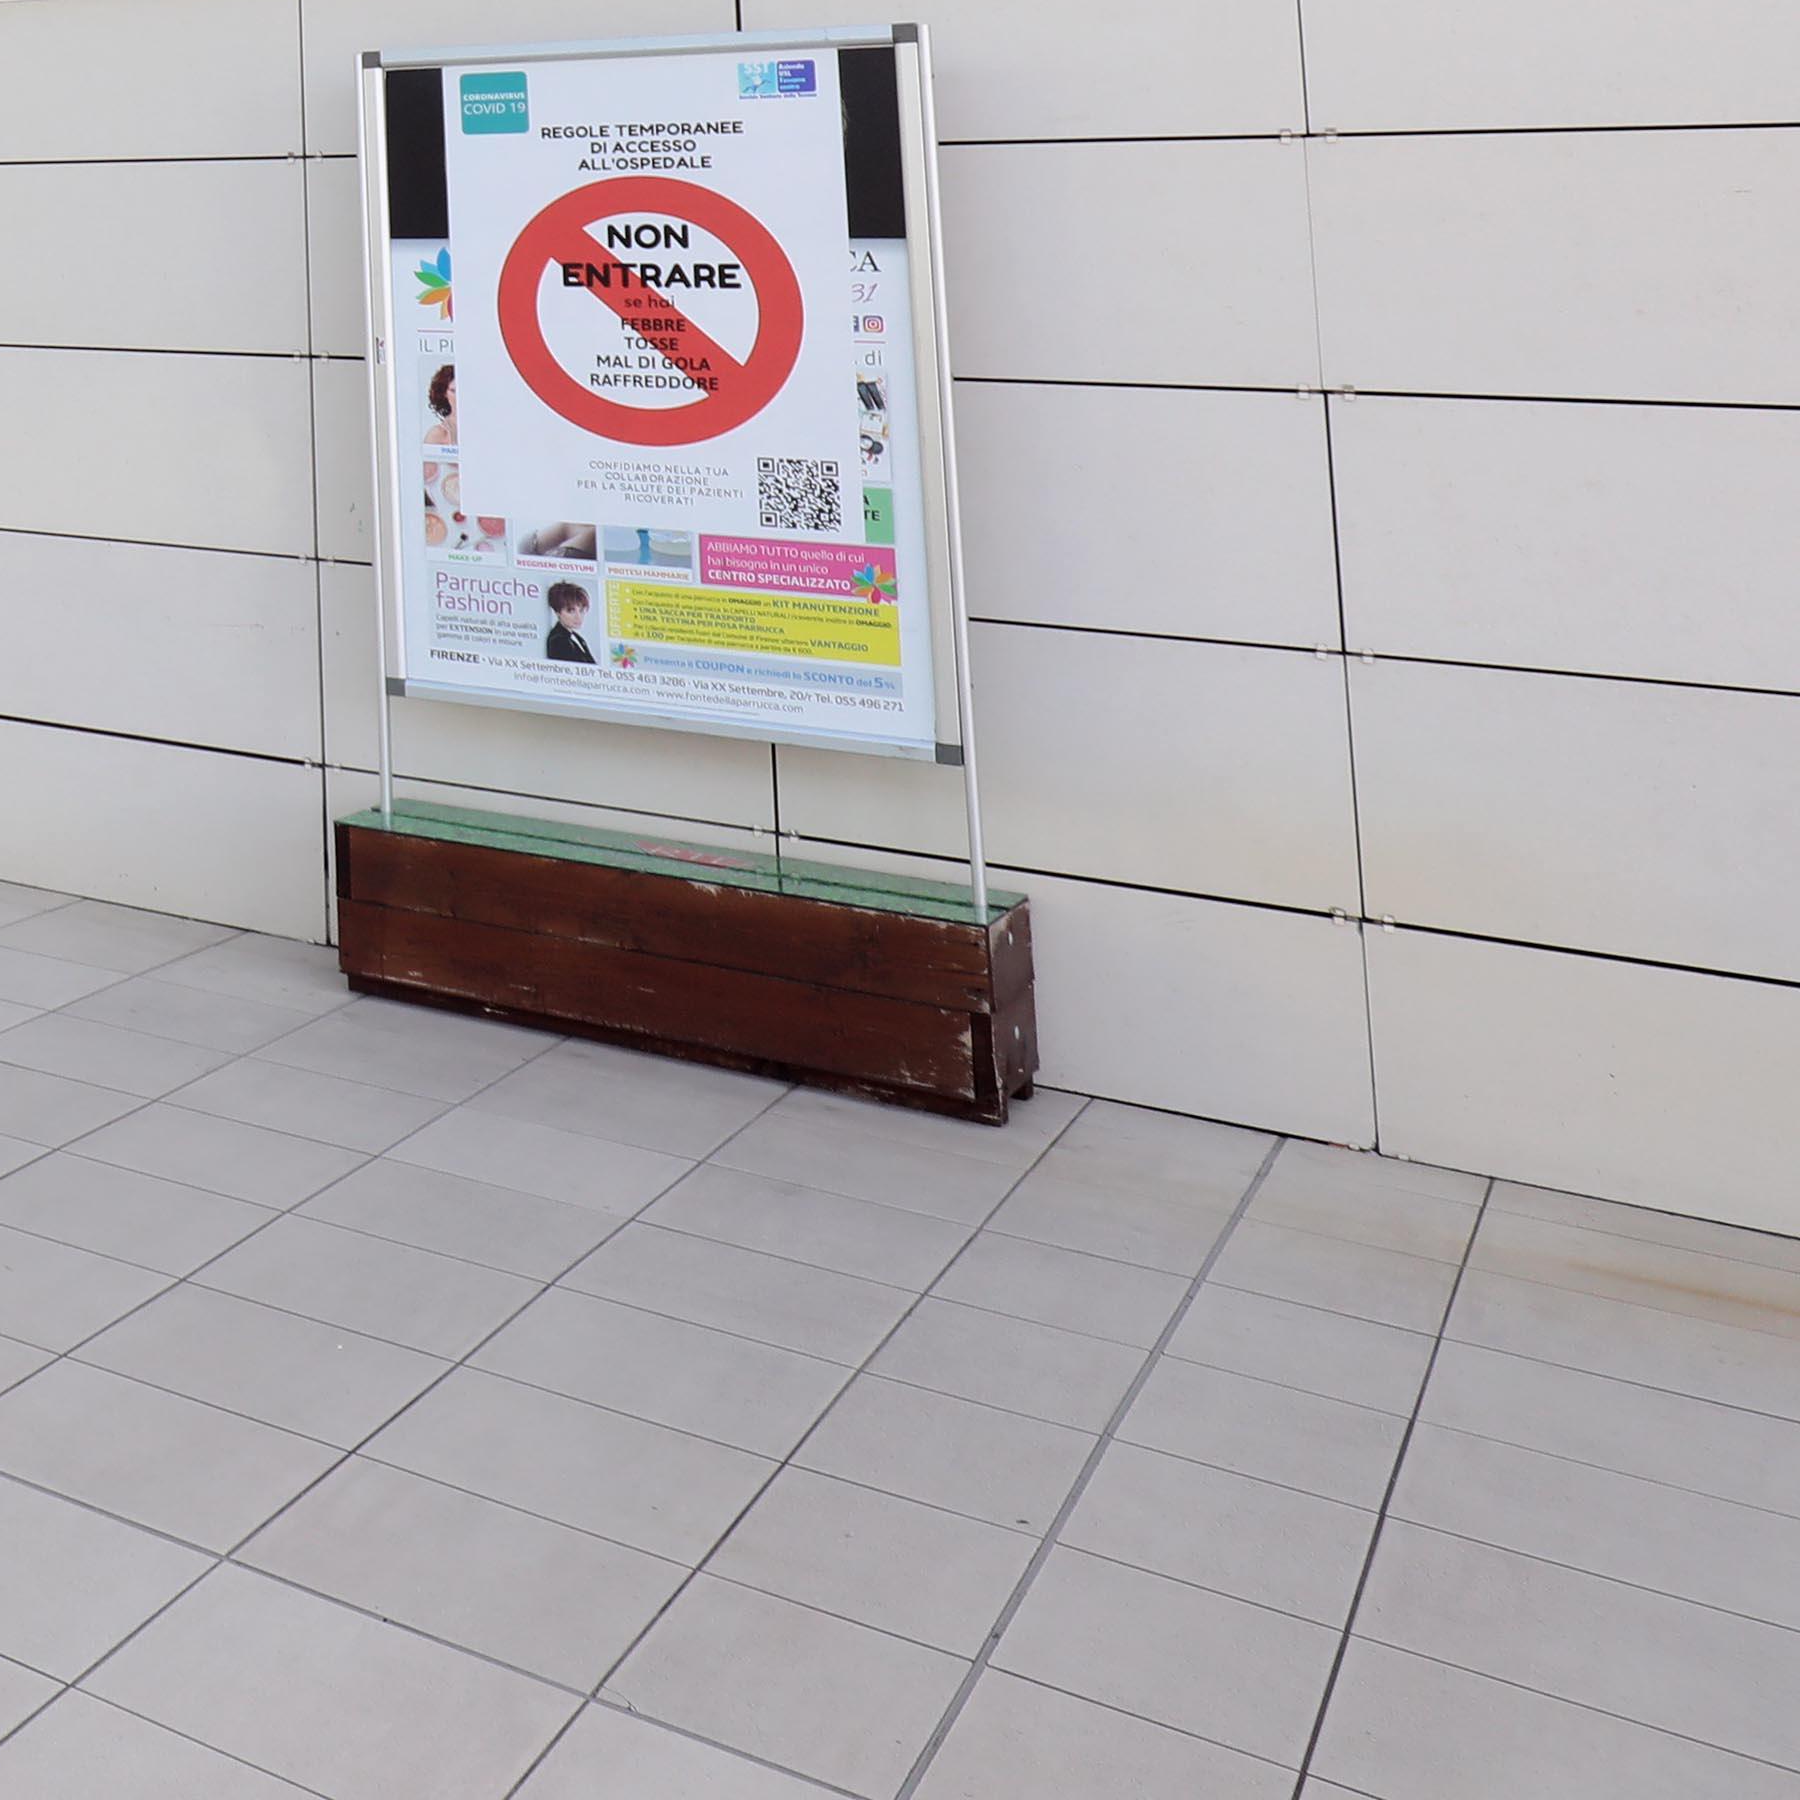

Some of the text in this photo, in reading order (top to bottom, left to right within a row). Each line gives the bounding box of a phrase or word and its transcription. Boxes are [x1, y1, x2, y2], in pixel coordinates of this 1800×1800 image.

[463, 92, 525, 101] CORONAVIRUS
[463, 101, 526, 115] COVID 19
[541, 121, 744, 139] REGOLE TEMPORANEE
[590, 139, 696, 154] DI ACCESSO
[578, 155, 712, 171] ALL'OSPEDALE
[607, 224, 689, 249] NON
[561, 262, 742, 289] ENTRARE
[624, 295, 675, 309] se hai
[621, 317, 686, 332] FEBBRE
[624, 336, 679, 351] TOSSE
[596, 354, 711, 371] MAL DI GOLA
[865, 349, 882, 366] di
[590, 373, 719, 391] RAFFREDDORE
[589, 460, 729, 477] CONFIDIAMO NELLA TUA
[604, 471, 709, 486] COLLABORAZIONE
[577, 479, 744, 498] PER LA SALUTE DEI PAZIENTI
[624, 493, 694, 506] RICOVERATI
[707, 541, 865, 563] ABBIAMO TUTTO quello di cui
[558, 562, 595, 573] COSTUMI
[707, 555, 829, 574] hai bisogno in un unico
[435, 571, 539, 598] Parrucche
[708, 570, 851, 591] CENTRO SPECIALIZZATO
[435, 590, 512, 615] fashion
[772, 600, 792, 609] KIT
[793, 602, 880, 616] MANUTENZIONE
[705, 613, 756, 623] TRASPORTO
[449, 624, 493, 634] EXTENSION
[809, 640, 869, 652] VANTAGGIO
[643, 655, 686, 667] Presenta
[695, 661, 744, 674] COUPON
[803, 671, 854, 685] SCONTO
[430, 649, 480, 664] FIRENZE
[488, 656, 502, 666] Via
[504, 658, 518, 668] XX
[520, 660, 573, 675] Settembre,
[616, 671, 635, 681] 055
[637, 673, 657, 684] 463
[692, 680, 709, 690] Via
[710, 682, 726, 692] XX
[728, 683, 787, 700] Settembre,
[790, 690, 813, 702] 20/r
[814, 693, 832, 704] Tel.
[835, 695, 856, 707] 055
[858, 697, 881, 709] 496
[883, 700, 904, 712] 271
[655, 688, 804, 714] www.fontedellaparrucca.com
